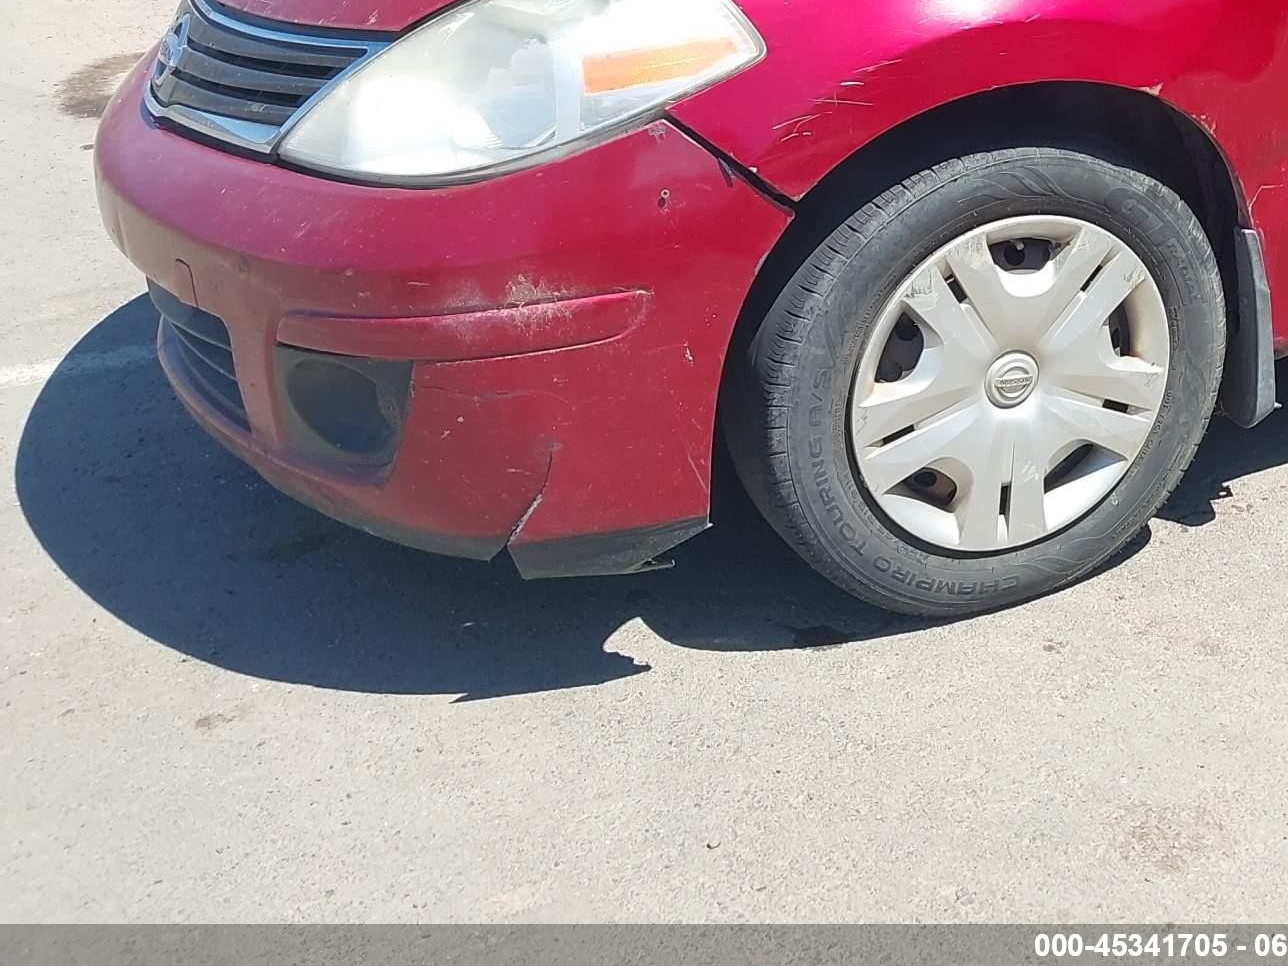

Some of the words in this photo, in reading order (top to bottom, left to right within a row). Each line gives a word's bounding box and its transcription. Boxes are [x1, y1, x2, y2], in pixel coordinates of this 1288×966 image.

[808, 367, 830, 428] A/S
[807, 436, 872, 557] TOURING
[873, 554, 1022, 597] CHAMPIRO
